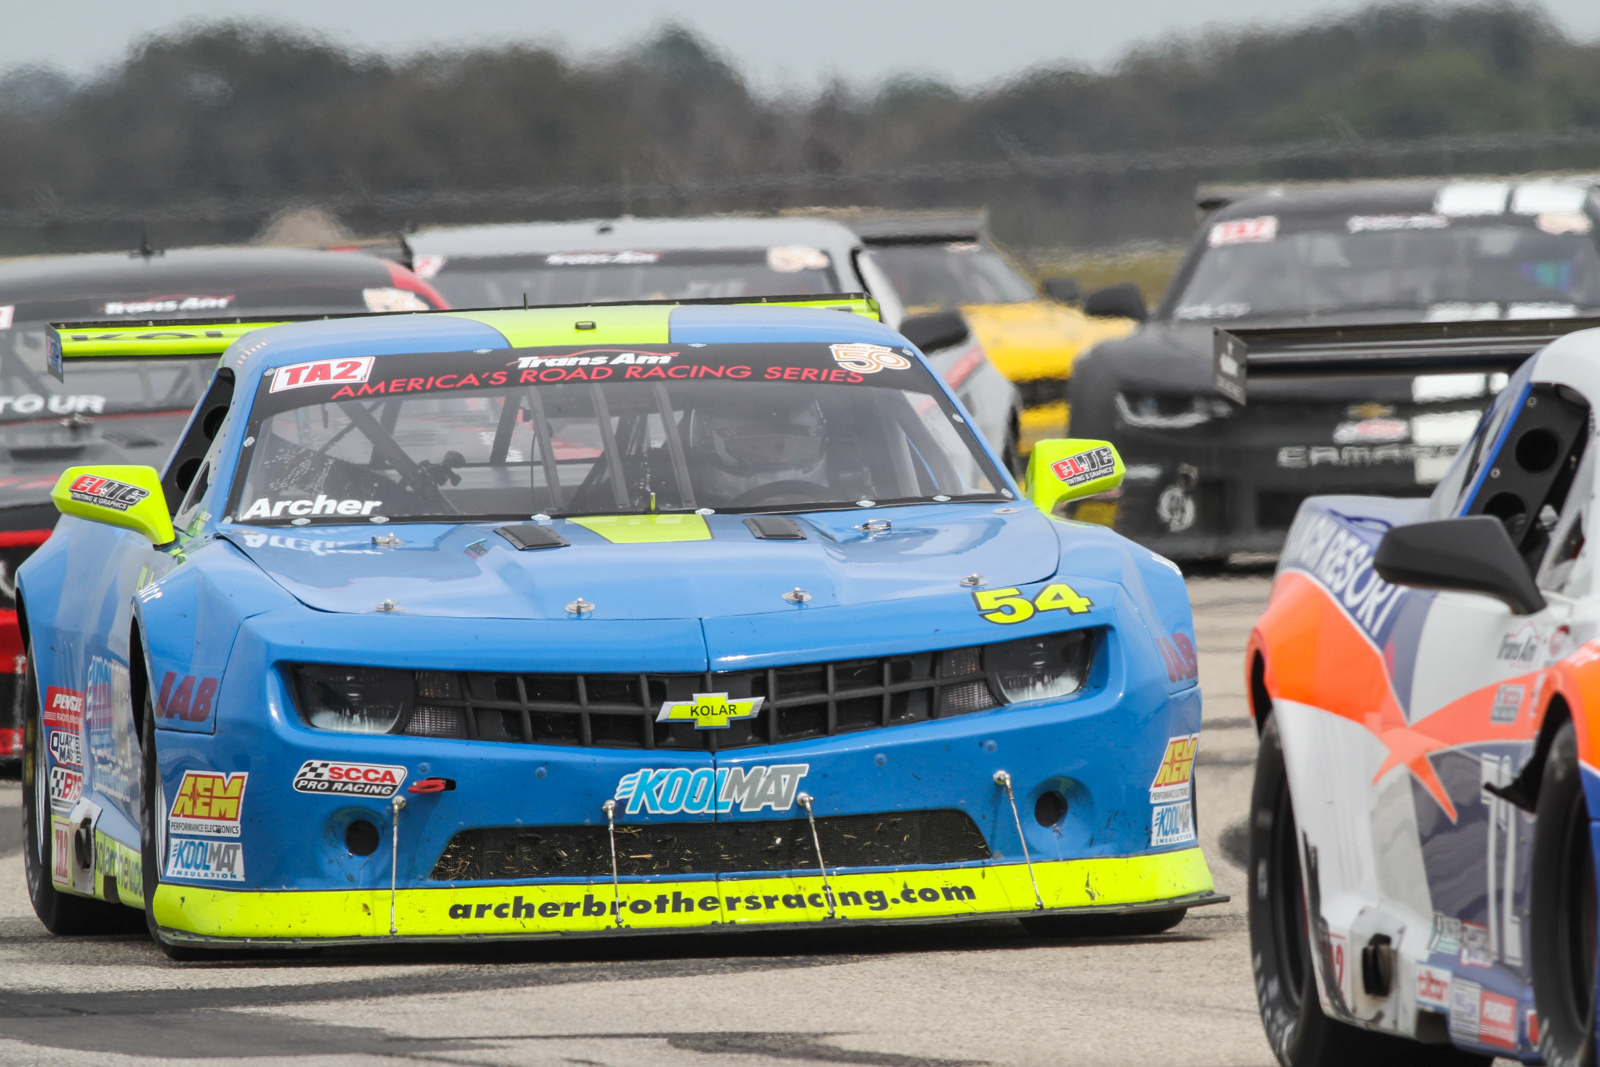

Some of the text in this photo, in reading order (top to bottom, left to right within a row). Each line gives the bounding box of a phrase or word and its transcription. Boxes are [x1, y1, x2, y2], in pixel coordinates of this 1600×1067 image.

[284, 360, 363, 387] TA2
[517, 352, 672, 370] Trans Am
[830, 348, 911, 374] 50
[330, 365, 864, 400] AMERICA'S ROAD RACING SERIES
[242, 495, 383, 519] Archer
[971, 583, 1096, 625] 54
[690, 704, 737, 717] KOLAR
[297, 780, 393, 795] PRO RACING
[328, 766, 397, 784] SCCA
[622, 764, 809, 815] KOOLMAT
[170, 822, 204, 832] PERFORMANCE
[173, 840, 241, 872] KOOLMAT
[171, 869, 237, 880] INSULATION
[449, 885, 977, 918] archerbrothersracing.com
